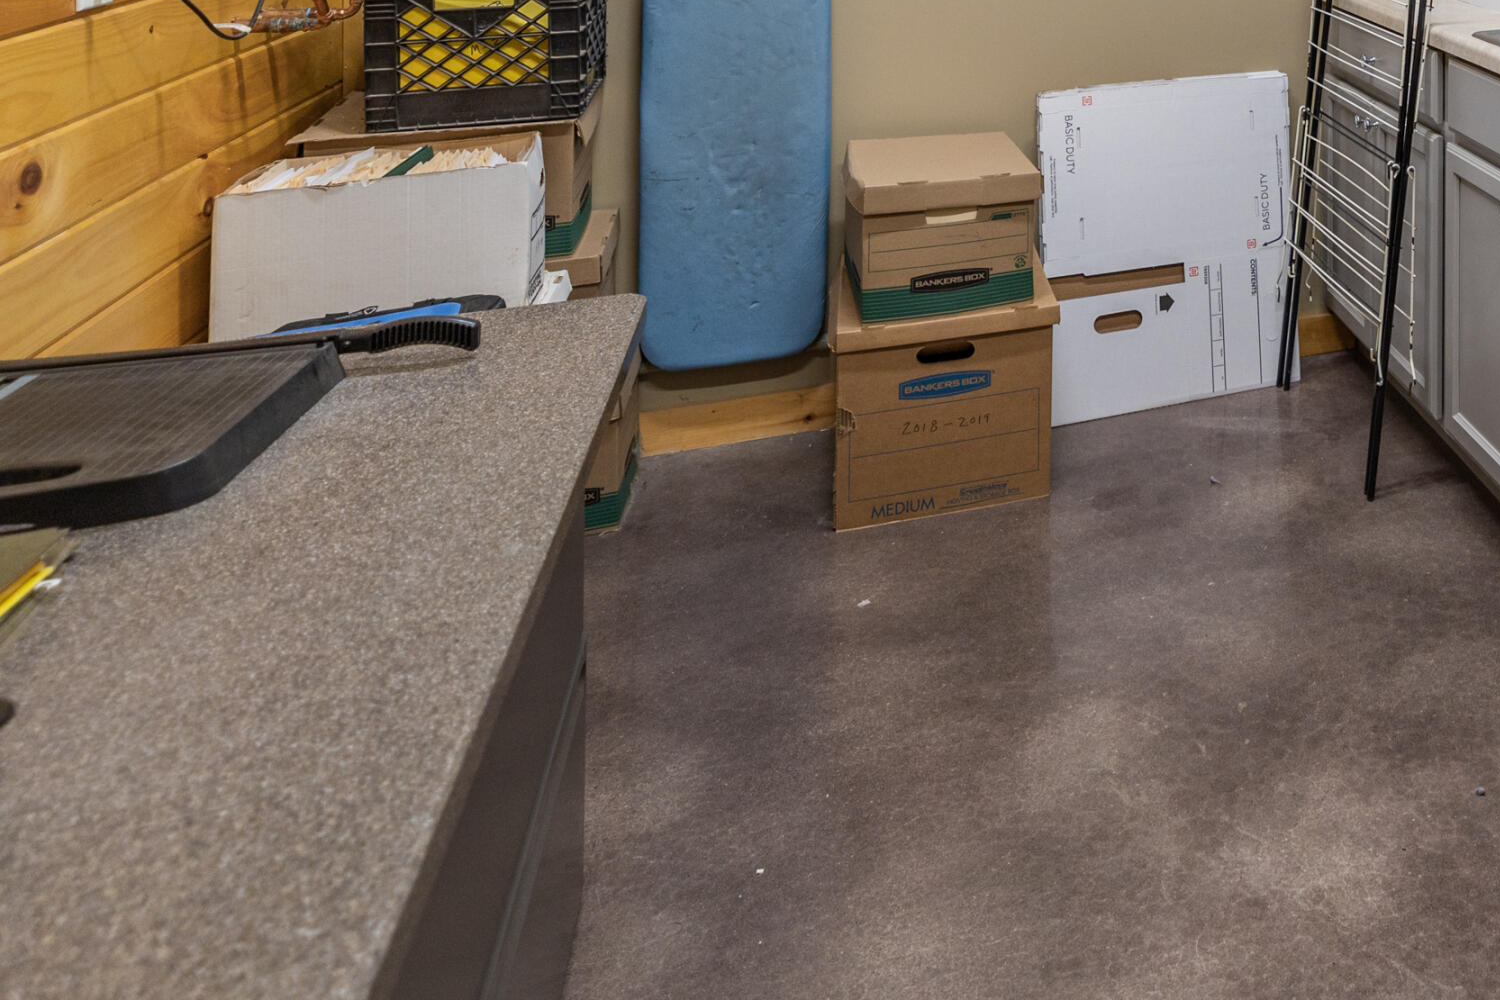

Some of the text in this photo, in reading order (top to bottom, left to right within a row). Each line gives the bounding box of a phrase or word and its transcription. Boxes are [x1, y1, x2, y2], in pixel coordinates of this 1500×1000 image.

[1064, 114, 1076, 175] BASIC DUTY
[1259, 173, 1271, 231] BASIC DUTY
[914, 273, 986, 288] BANKERS BOX
[904, 376, 986, 394] BANKERS BOX
[902, 419, 938, 435] 2018
[870, 497, 935, 519] MEDIUM
